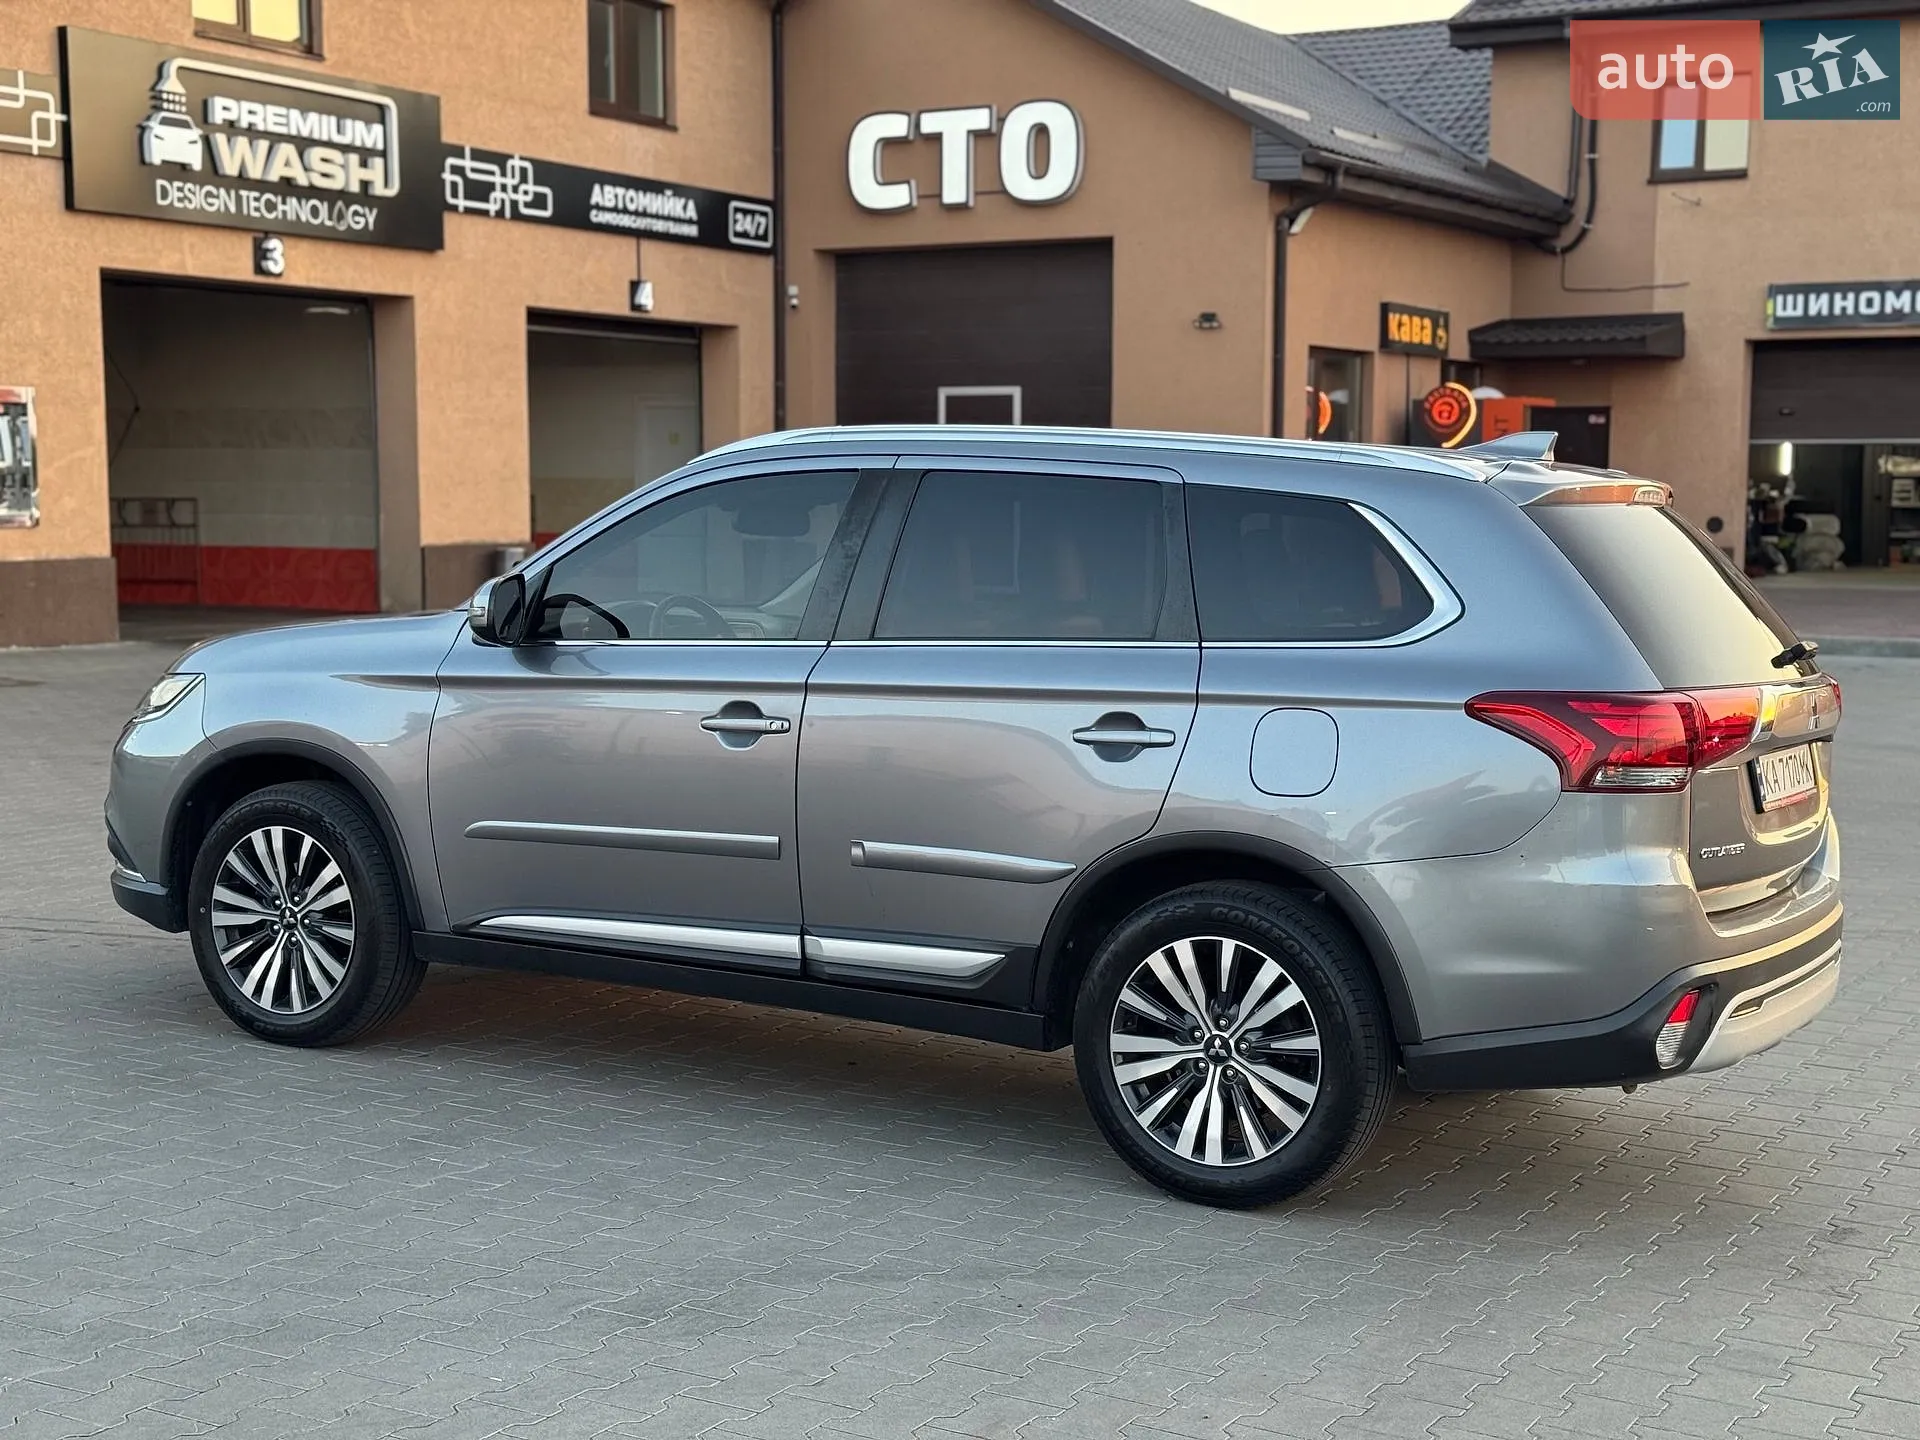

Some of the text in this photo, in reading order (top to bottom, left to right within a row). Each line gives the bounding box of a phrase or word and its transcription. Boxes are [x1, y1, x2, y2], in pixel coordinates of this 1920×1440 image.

[208, 95, 385, 150] PREMIUM
[210, 132, 386, 196] WASH
[847, 99, 1085, 211] СТО
[155, 178, 378, 231] DESIGN TECHNOLOGY
[590, 182, 698, 222] АВТОМИЙКА
[733, 212, 768, 237] 24/7
[259, 237, 285, 276] 3
[634, 281, 654, 312] 4
[1775, 289, 1920, 318] ШИНОМ
